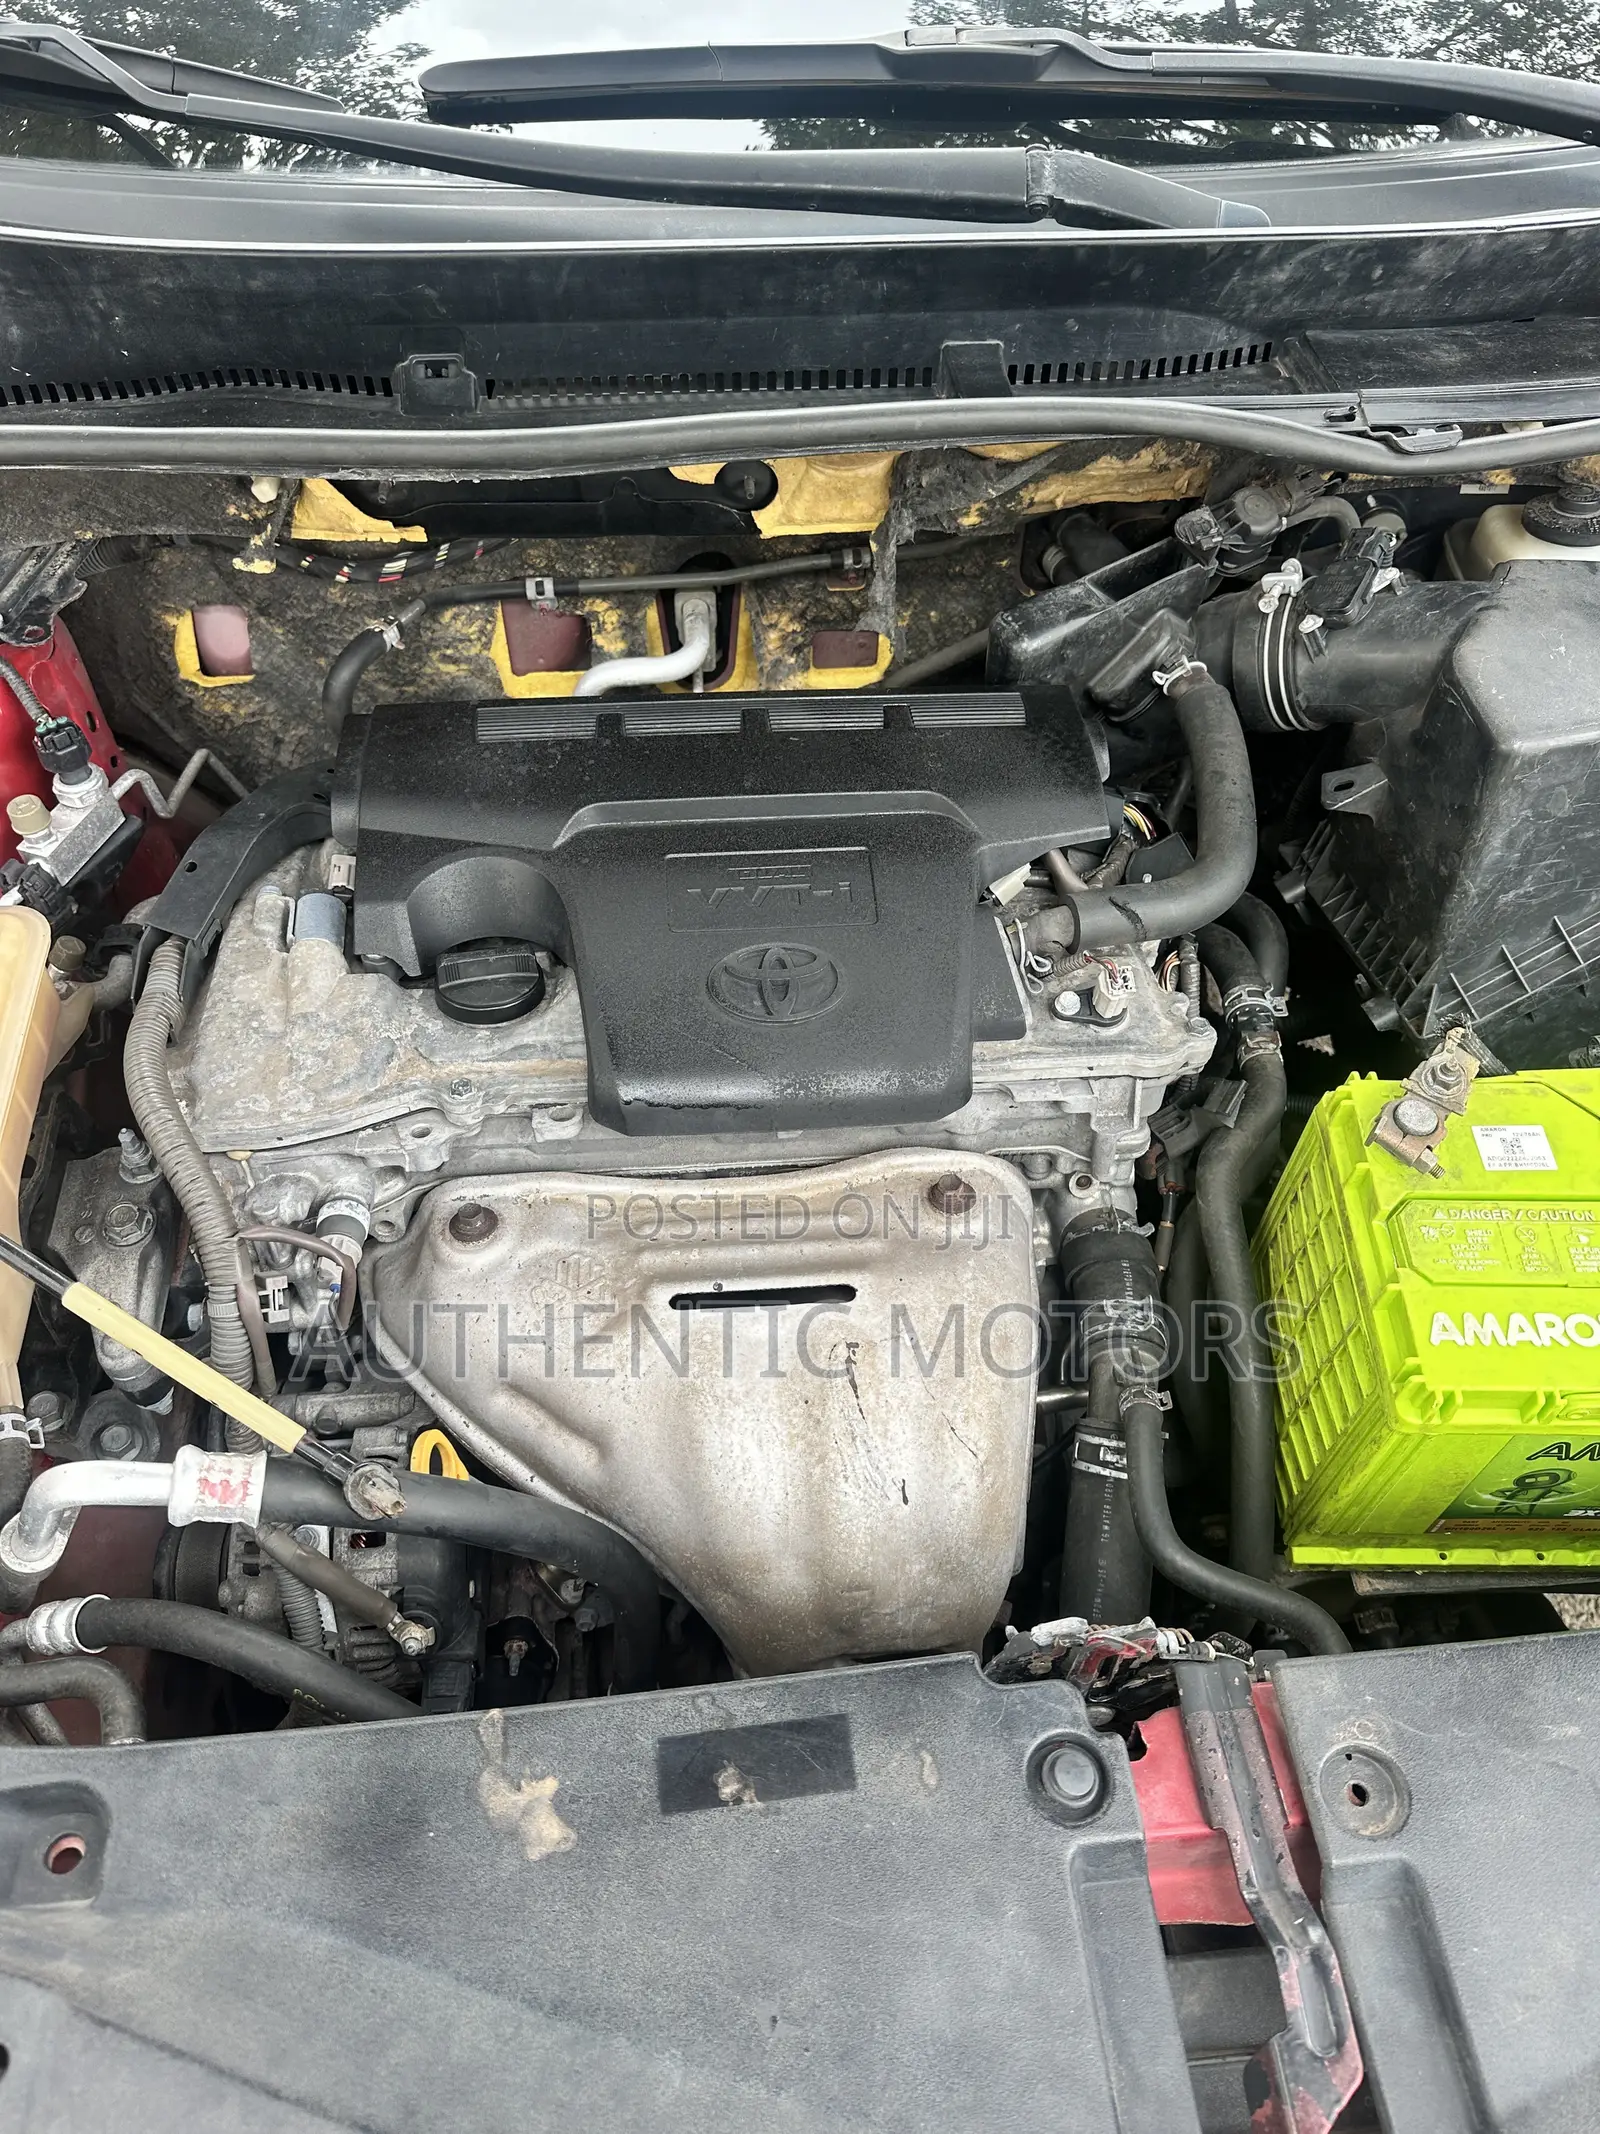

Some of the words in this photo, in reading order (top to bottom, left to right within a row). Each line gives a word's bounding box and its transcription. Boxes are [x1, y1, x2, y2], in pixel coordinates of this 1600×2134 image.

[1448, 1208, 1513, 1221] DANGER
[1515, 1209, 1524, 1221] /
[1527, 1209, 1597, 1222] CAUTION
[1430, 1311, 1600, 1348] AMARO
